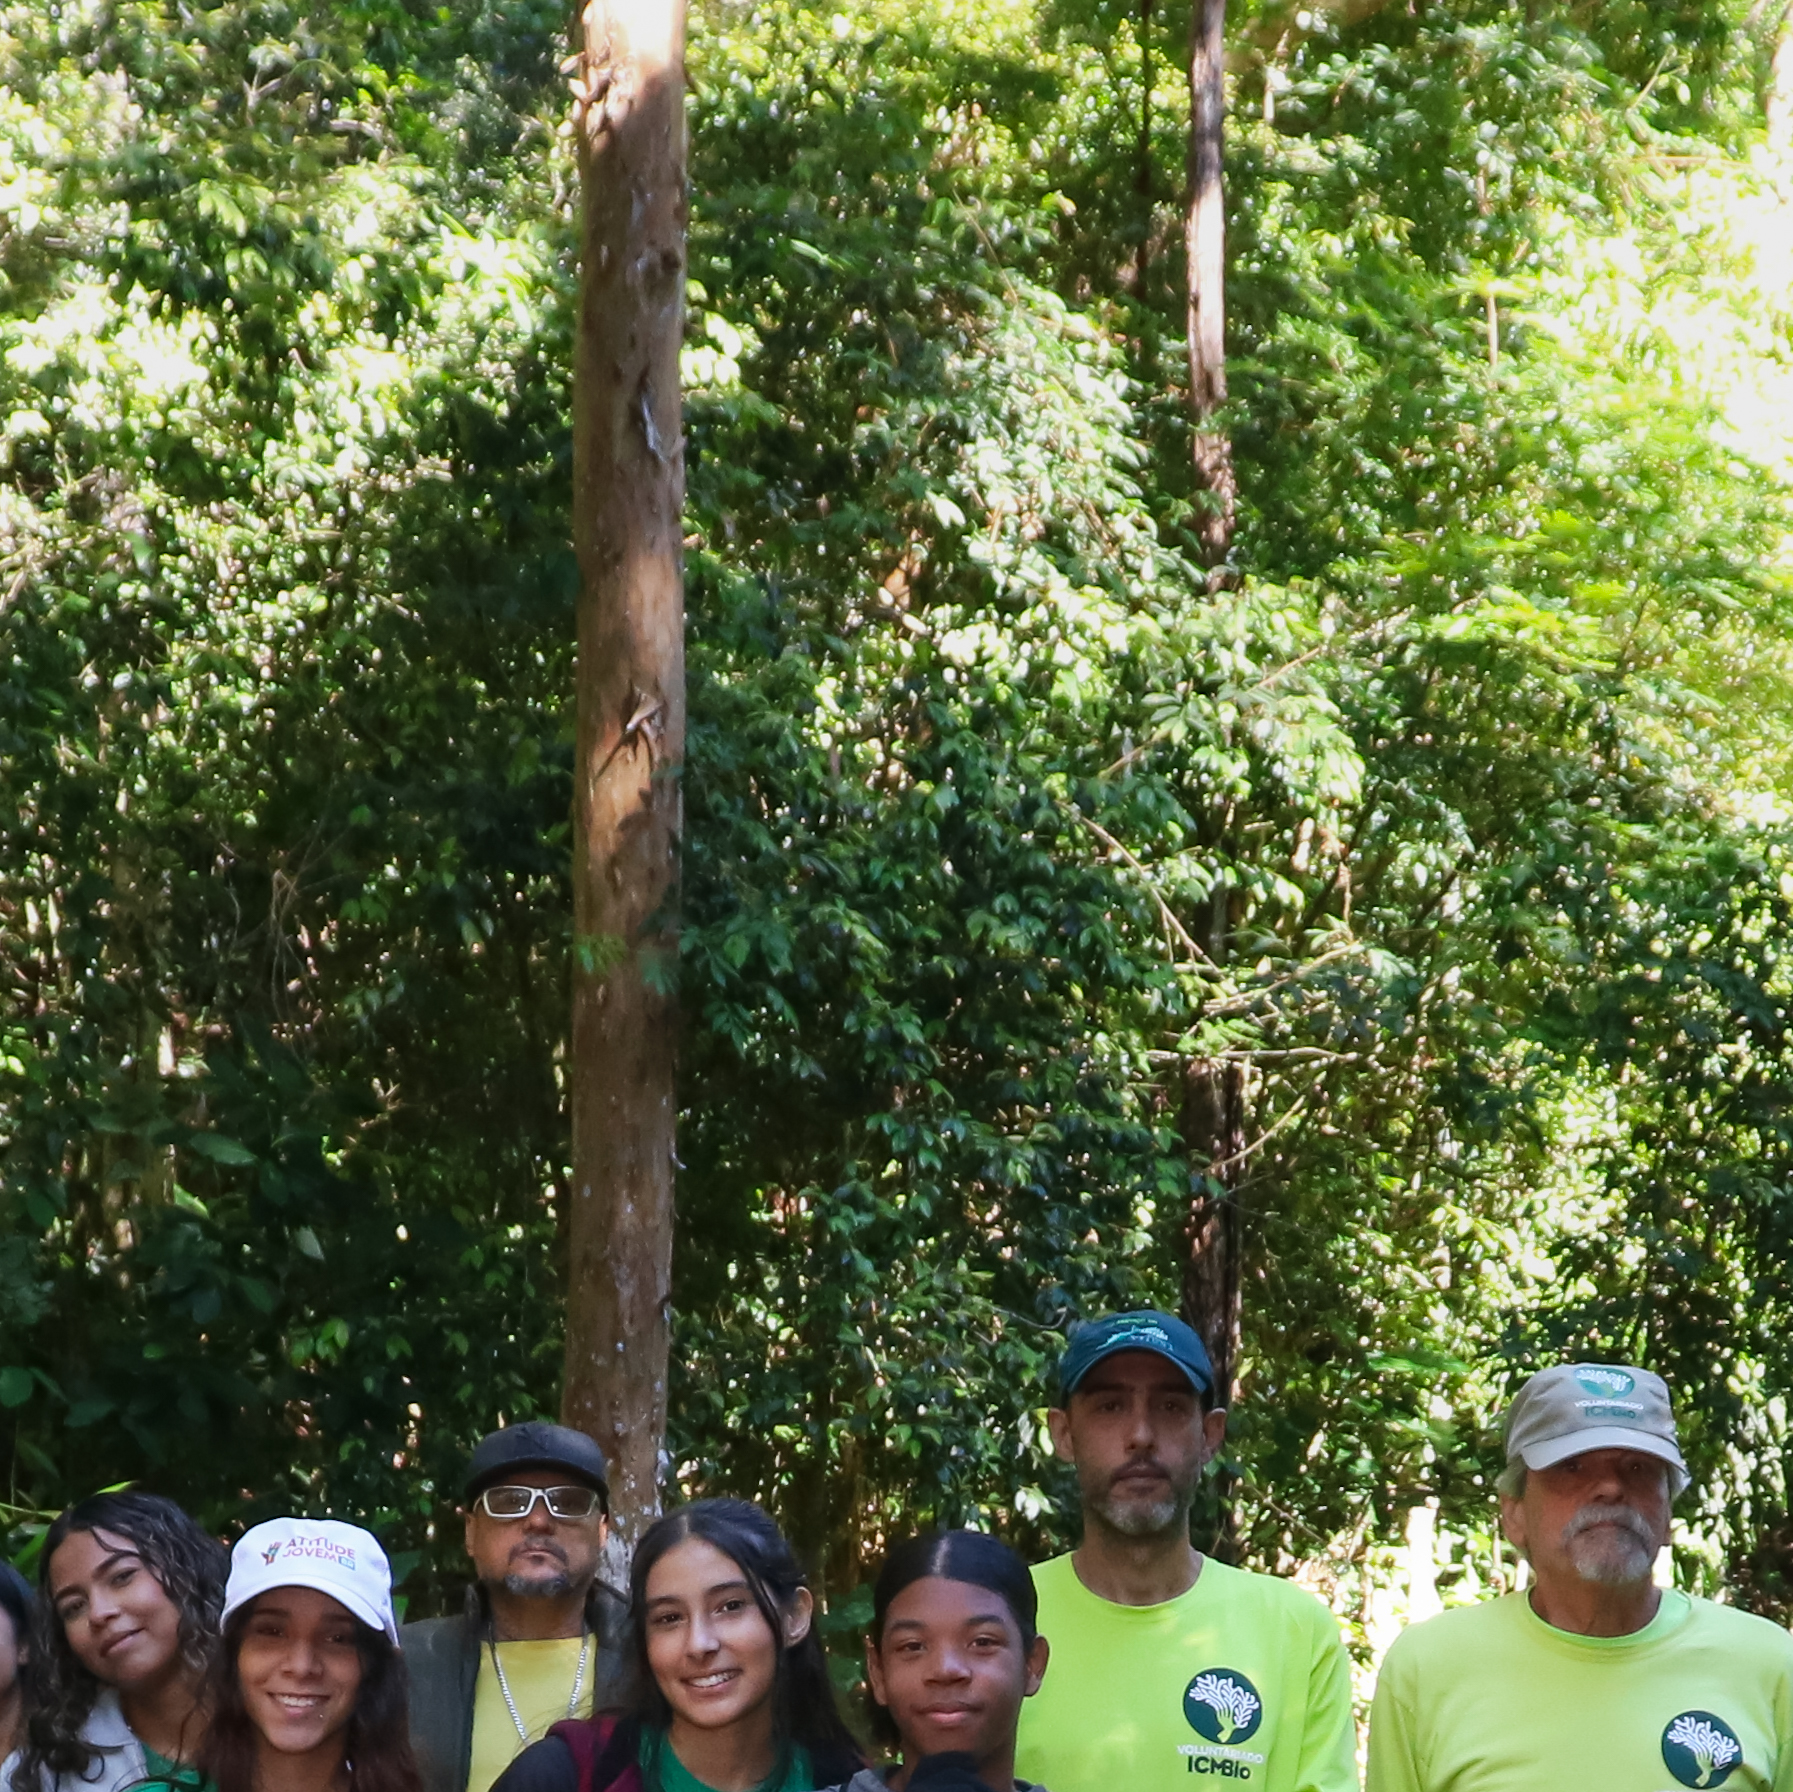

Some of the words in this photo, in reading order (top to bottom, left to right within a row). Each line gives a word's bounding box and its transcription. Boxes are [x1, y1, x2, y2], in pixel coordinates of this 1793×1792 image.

[283, 1547, 337, 1562] JOVEM
[287, 1536, 355, 1559] ATITUDE
[1177, 1745, 1264, 1764] VOLUNTARIADO
[1188, 1756, 1251, 1780] ICMBio
